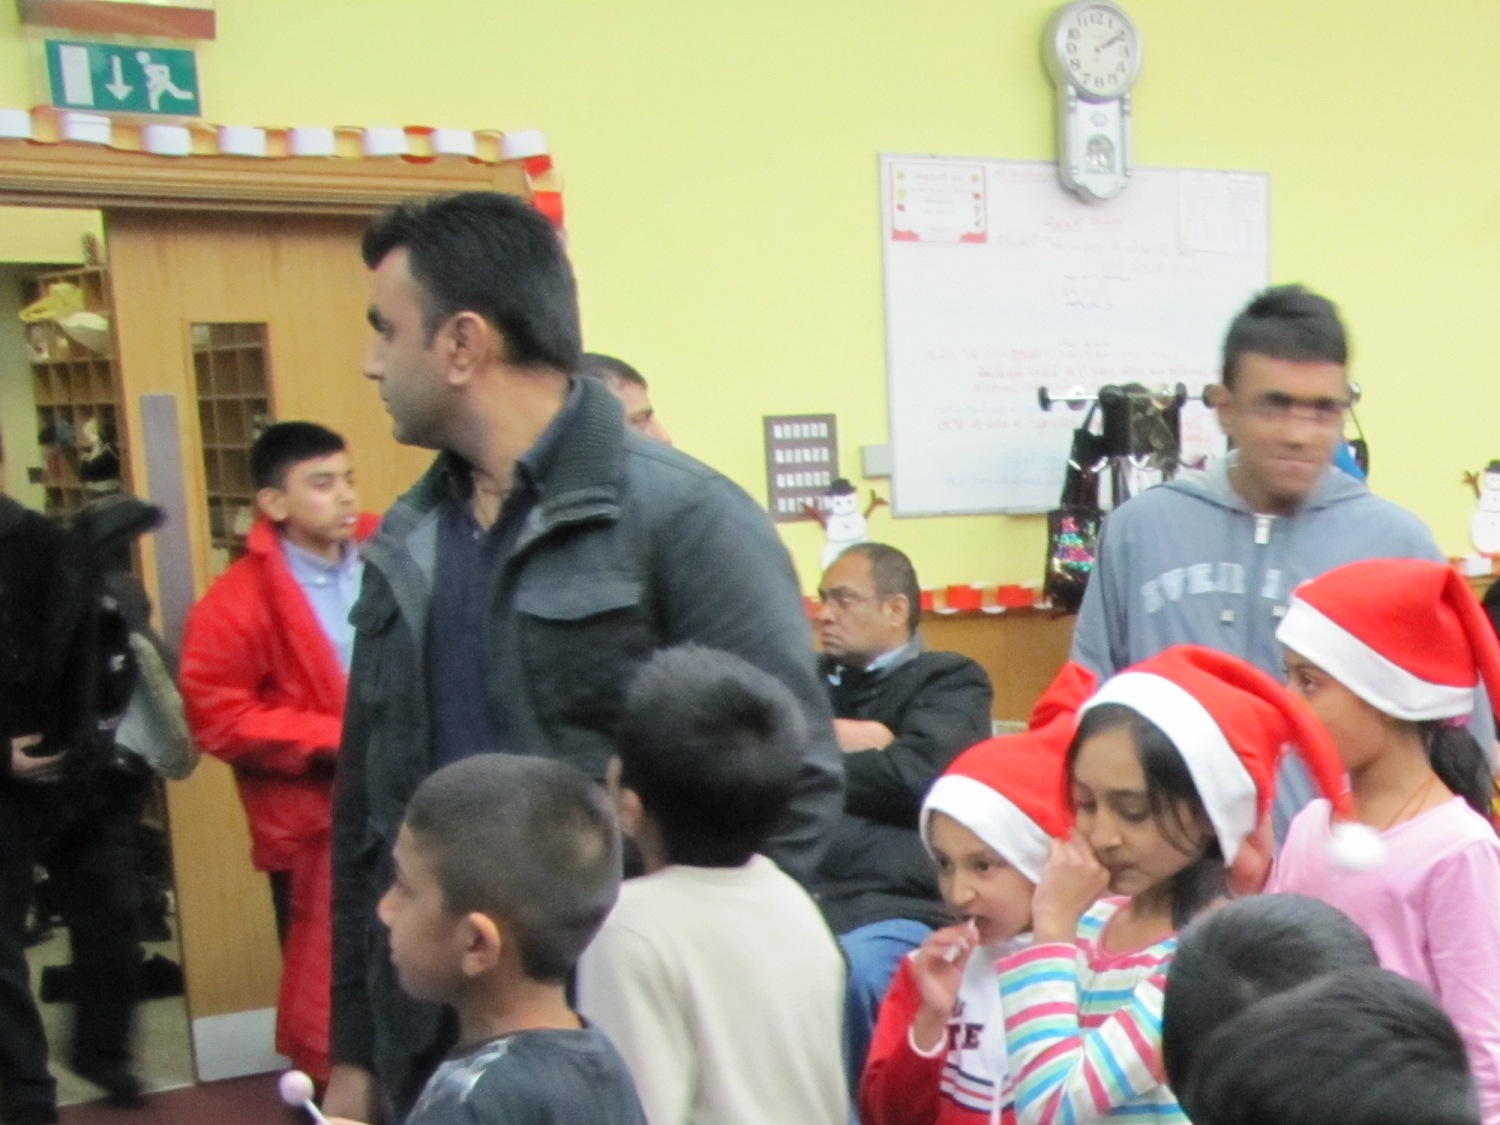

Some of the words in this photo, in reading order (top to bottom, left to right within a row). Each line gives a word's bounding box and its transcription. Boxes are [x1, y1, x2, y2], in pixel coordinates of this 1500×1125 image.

[1077, 16, 1088, 28] 11
[1090, 12, 1104, 25] 12
[1067, 27, 1080, 40] 10
[1066, 42, 1077, 55] 9
[1119, 45, 1129, 59] 3
[1070, 58, 1080, 71] 8
[1115, 60, 1125, 73] 4
[1081, 72, 1090, 85] 7
[1094, 76, 1105, 89] 6
[1107, 73, 1118, 86] 5
